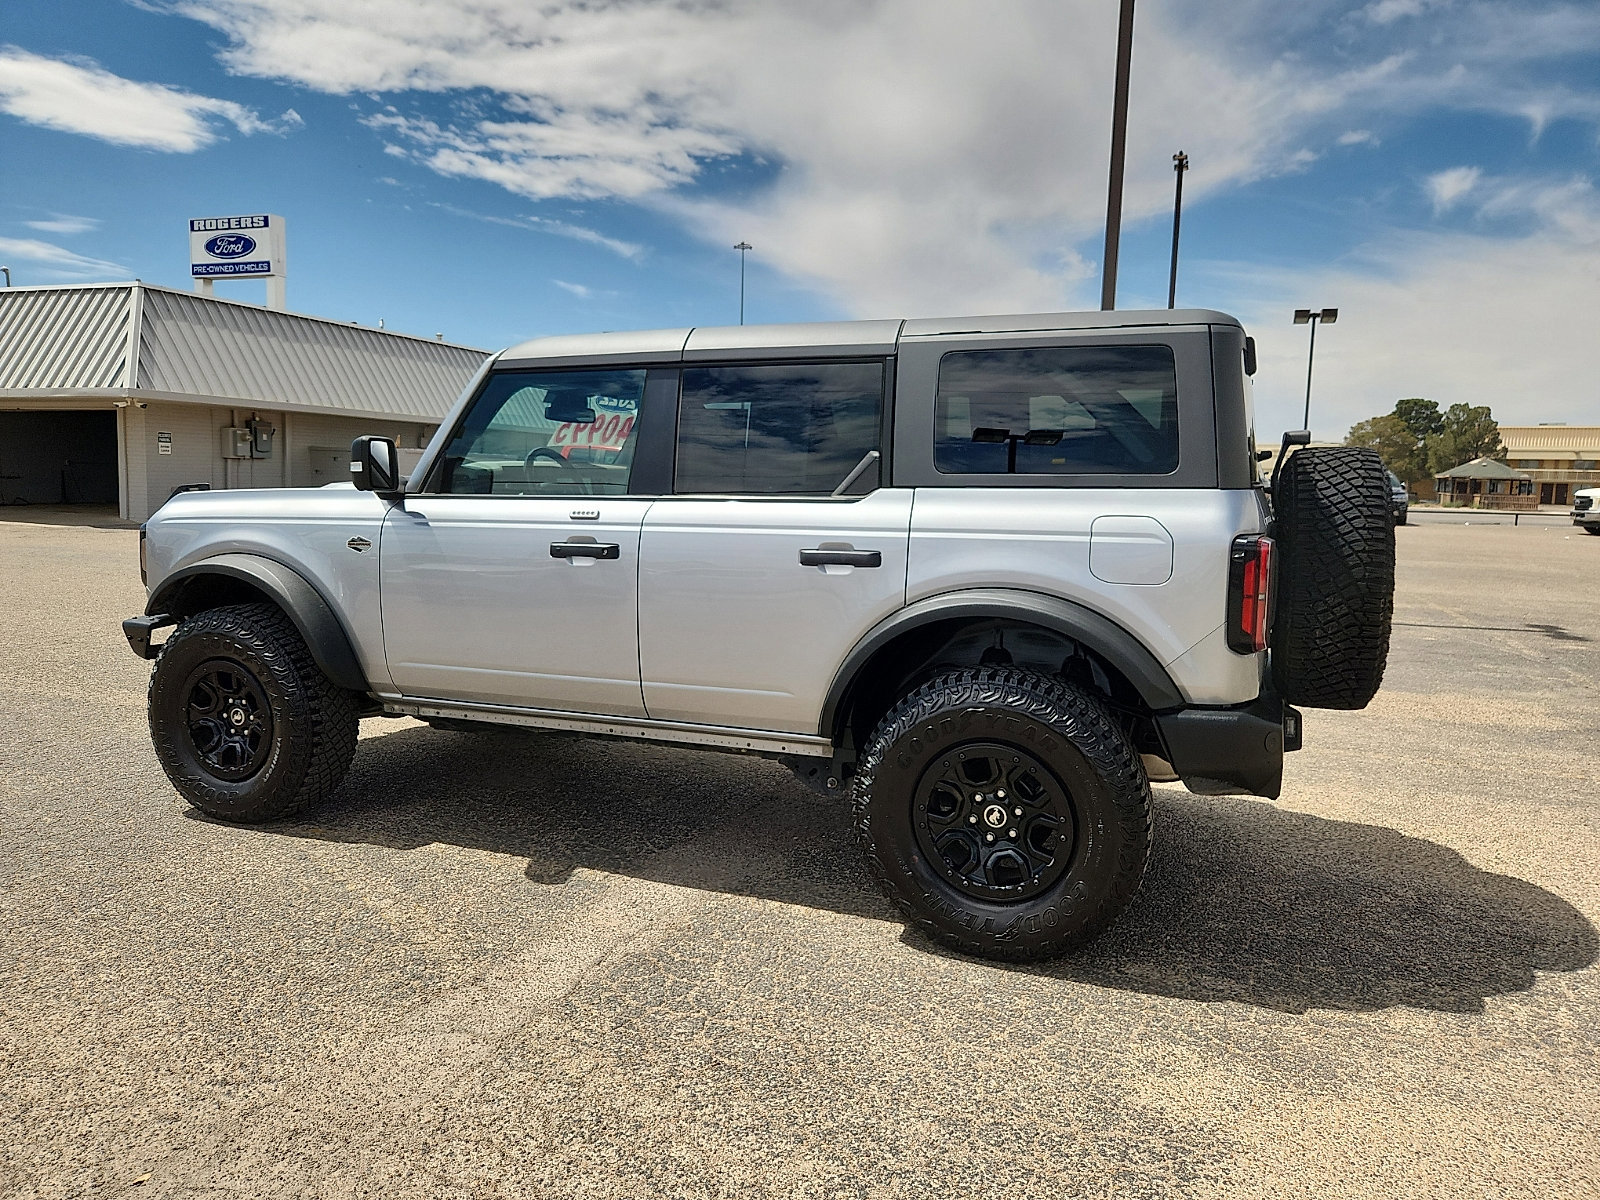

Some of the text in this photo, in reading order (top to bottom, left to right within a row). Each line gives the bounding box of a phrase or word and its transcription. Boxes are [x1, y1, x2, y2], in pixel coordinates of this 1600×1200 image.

[194, 217, 264, 230] ROGERS
[214, 237, 244, 254] Ford
[194, 265, 234, 273] PRE-OWNED
